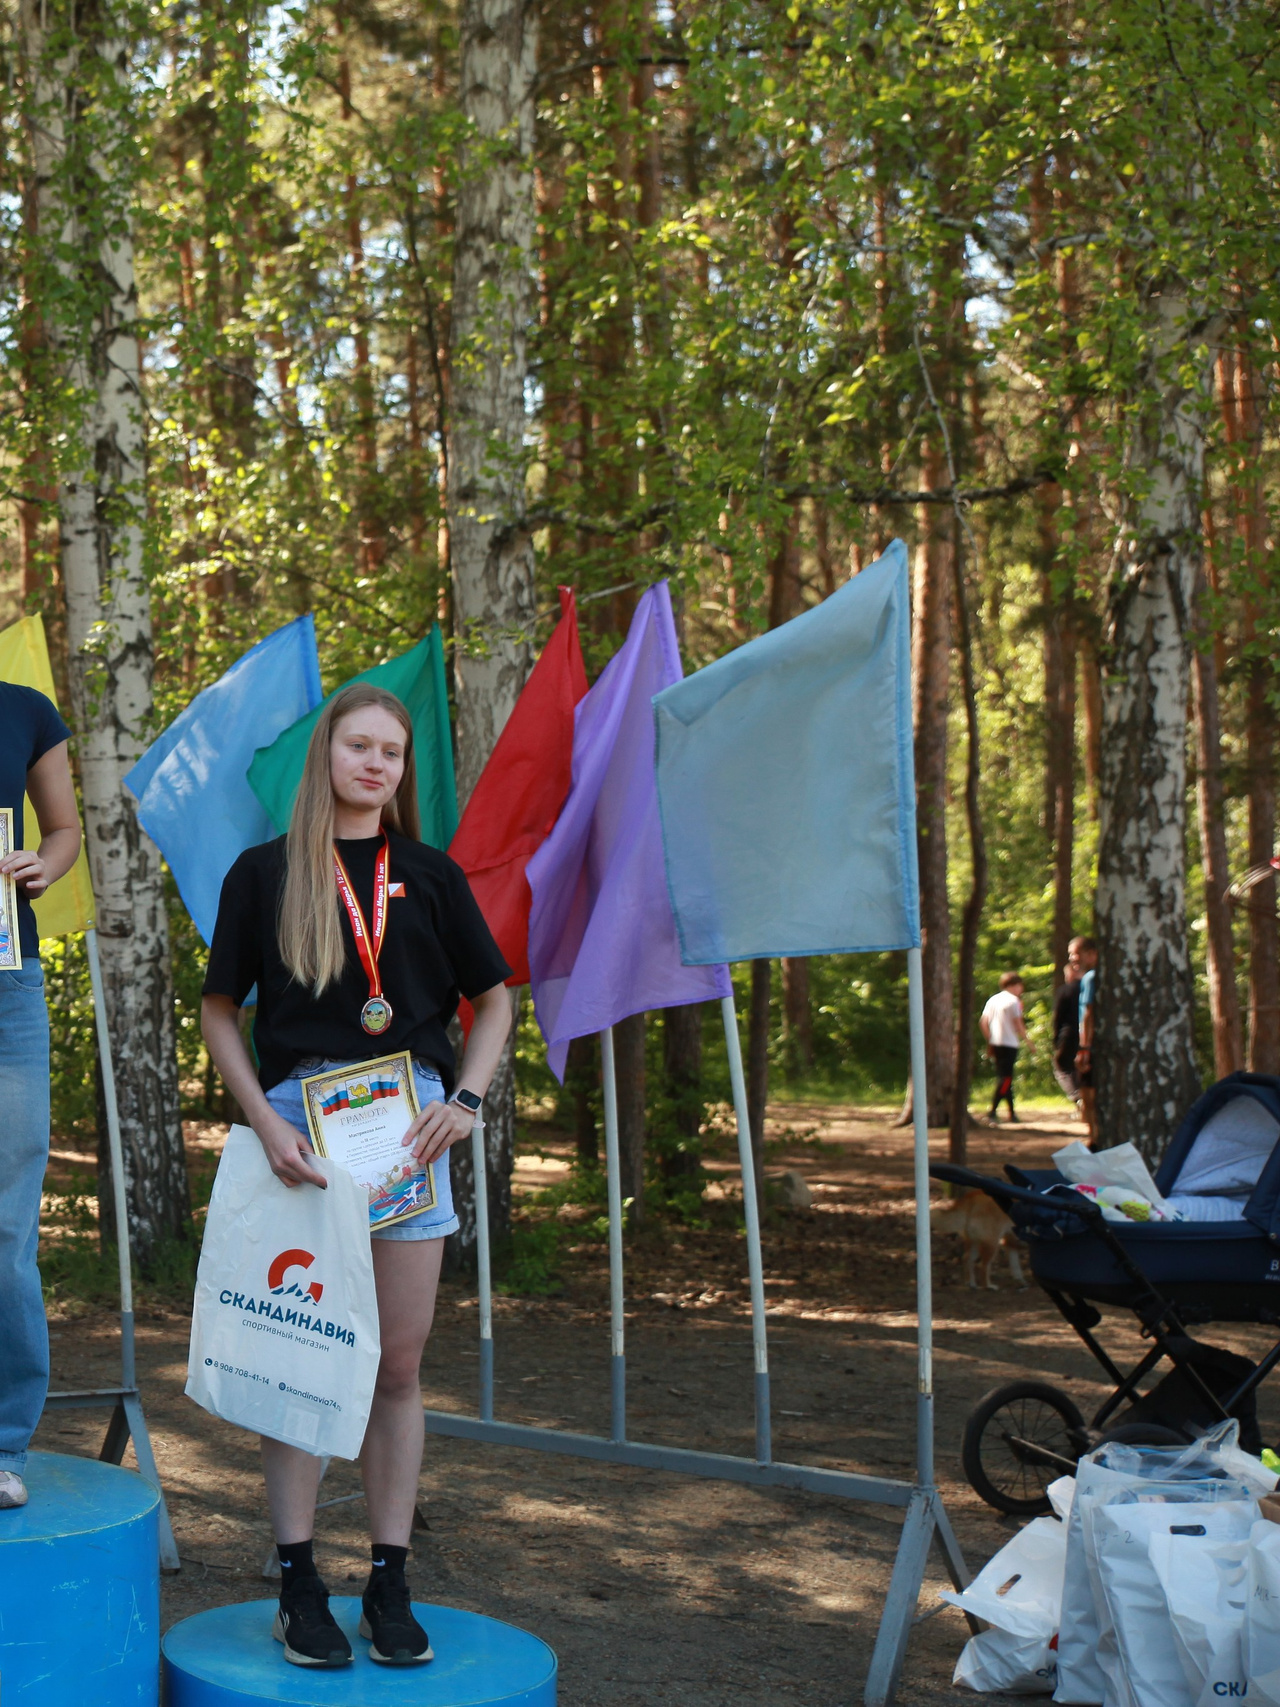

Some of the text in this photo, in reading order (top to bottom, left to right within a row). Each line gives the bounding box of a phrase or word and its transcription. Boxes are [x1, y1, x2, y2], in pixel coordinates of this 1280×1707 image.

[377, 874, 384, 882] 15
[342, 886, 355, 907] Марья
[376, 885, 385, 908] Марья
[351, 908, 359, 917] да
[378, 908, 384, 918] да
[355, 918, 363, 936] Иван
[340, 1106, 388, 1126] ГРАМОТА
[220, 1289, 355, 1348] СКАНДИНАВИЯ
[242, 1318, 330, 1352] спортивный магазин
[220, 1362, 234, 1374] 908
[235, 1367, 270, 1385] 708-41-14
[286, 1385, 342, 1412] skandinavia74.ru
